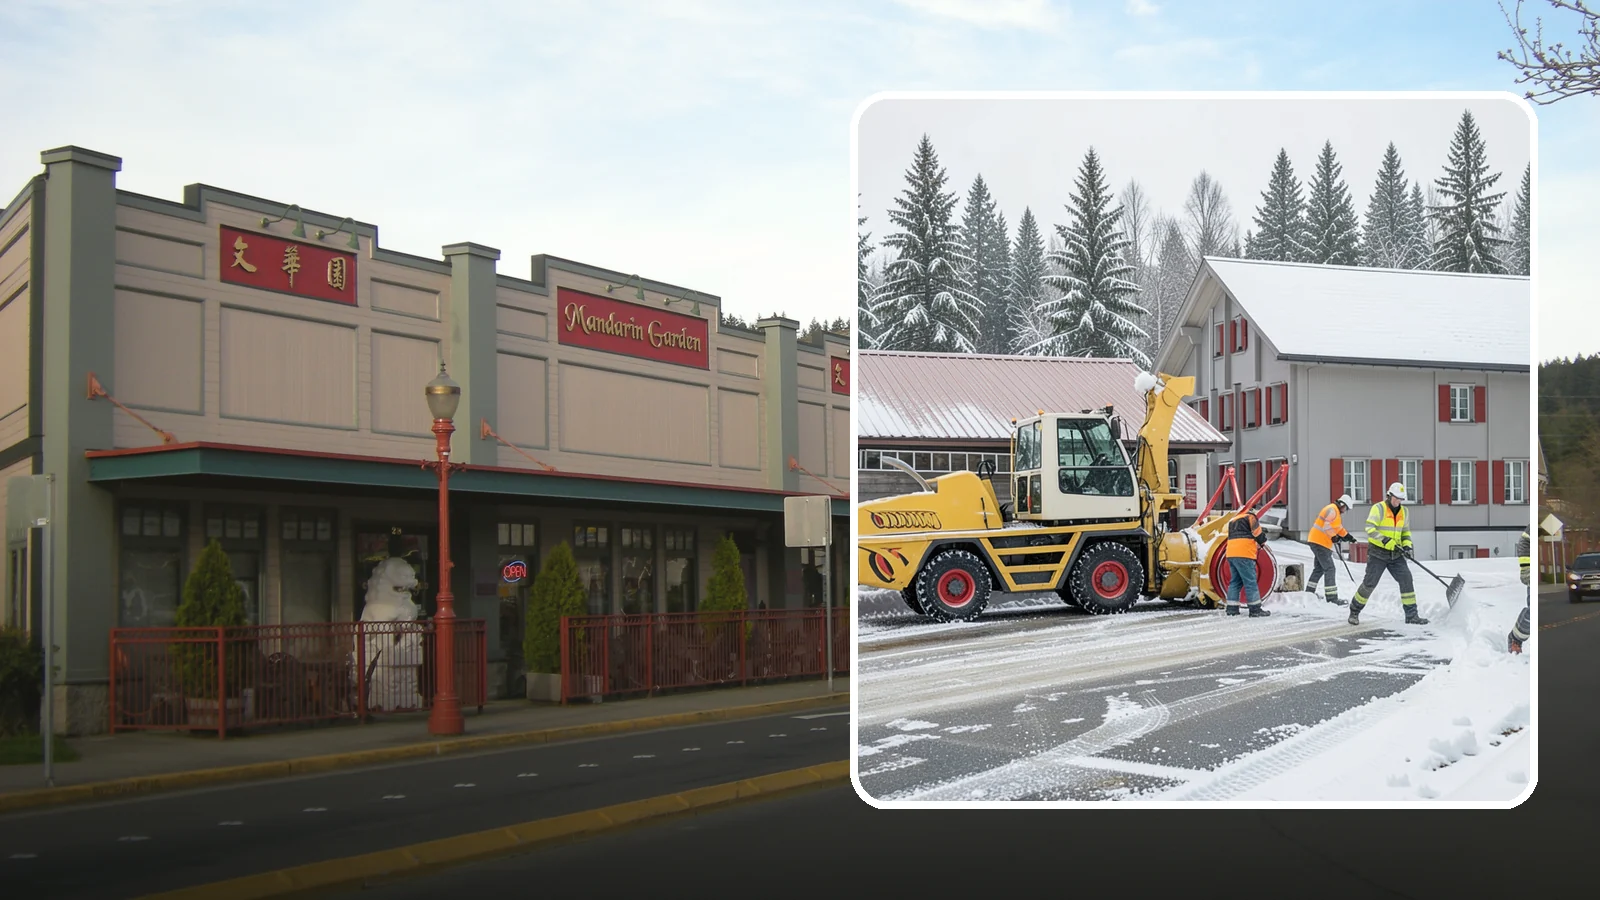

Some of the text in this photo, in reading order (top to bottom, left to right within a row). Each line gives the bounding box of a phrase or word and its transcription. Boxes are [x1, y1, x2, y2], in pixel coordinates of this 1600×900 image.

[230, 235, 346, 291] 文華園
[564, 302, 701, 352] Mandarin Garden
[503, 565, 527, 578] OPEN
